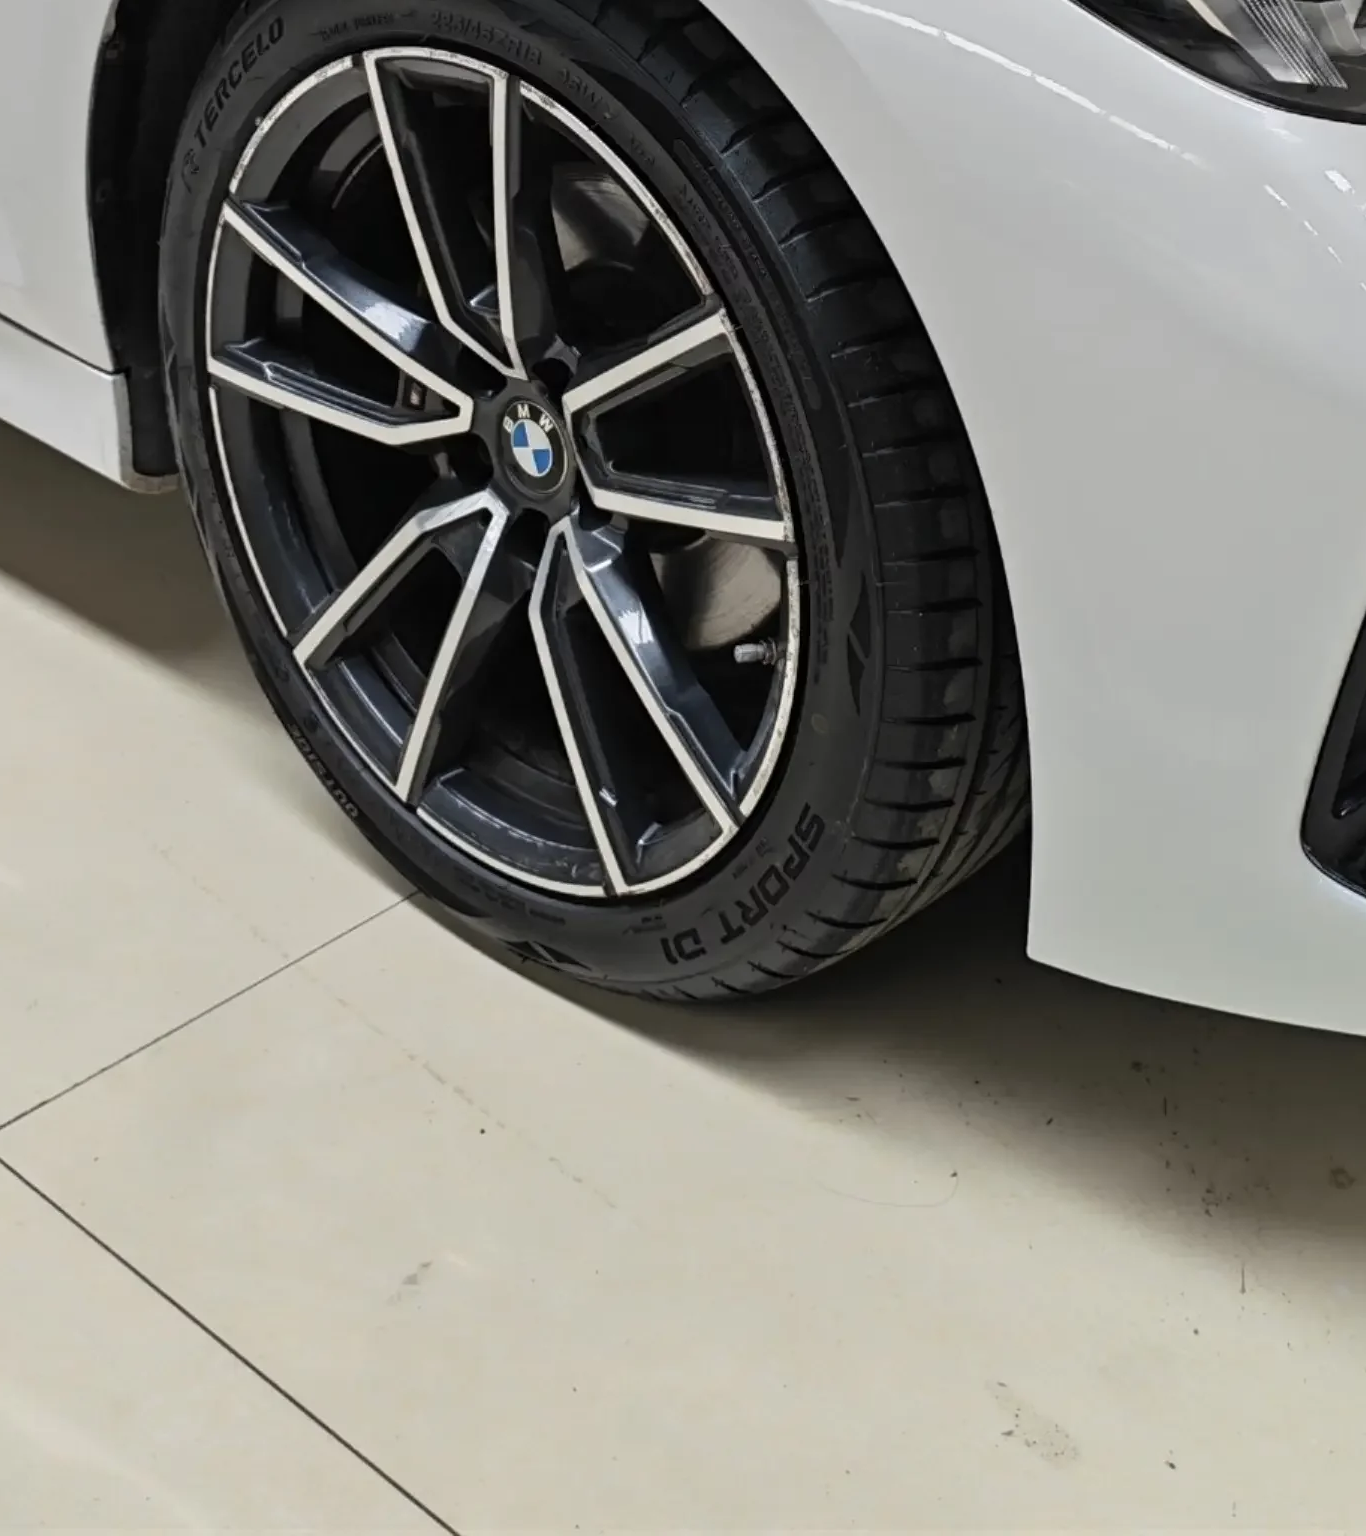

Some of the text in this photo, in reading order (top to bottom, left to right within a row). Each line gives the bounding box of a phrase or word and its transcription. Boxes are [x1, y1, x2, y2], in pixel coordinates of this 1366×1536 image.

[194, 16, 284, 148] TERCELO
[502, 403, 554, 434] BMW
[720, 802, 825, 944] SPORT
